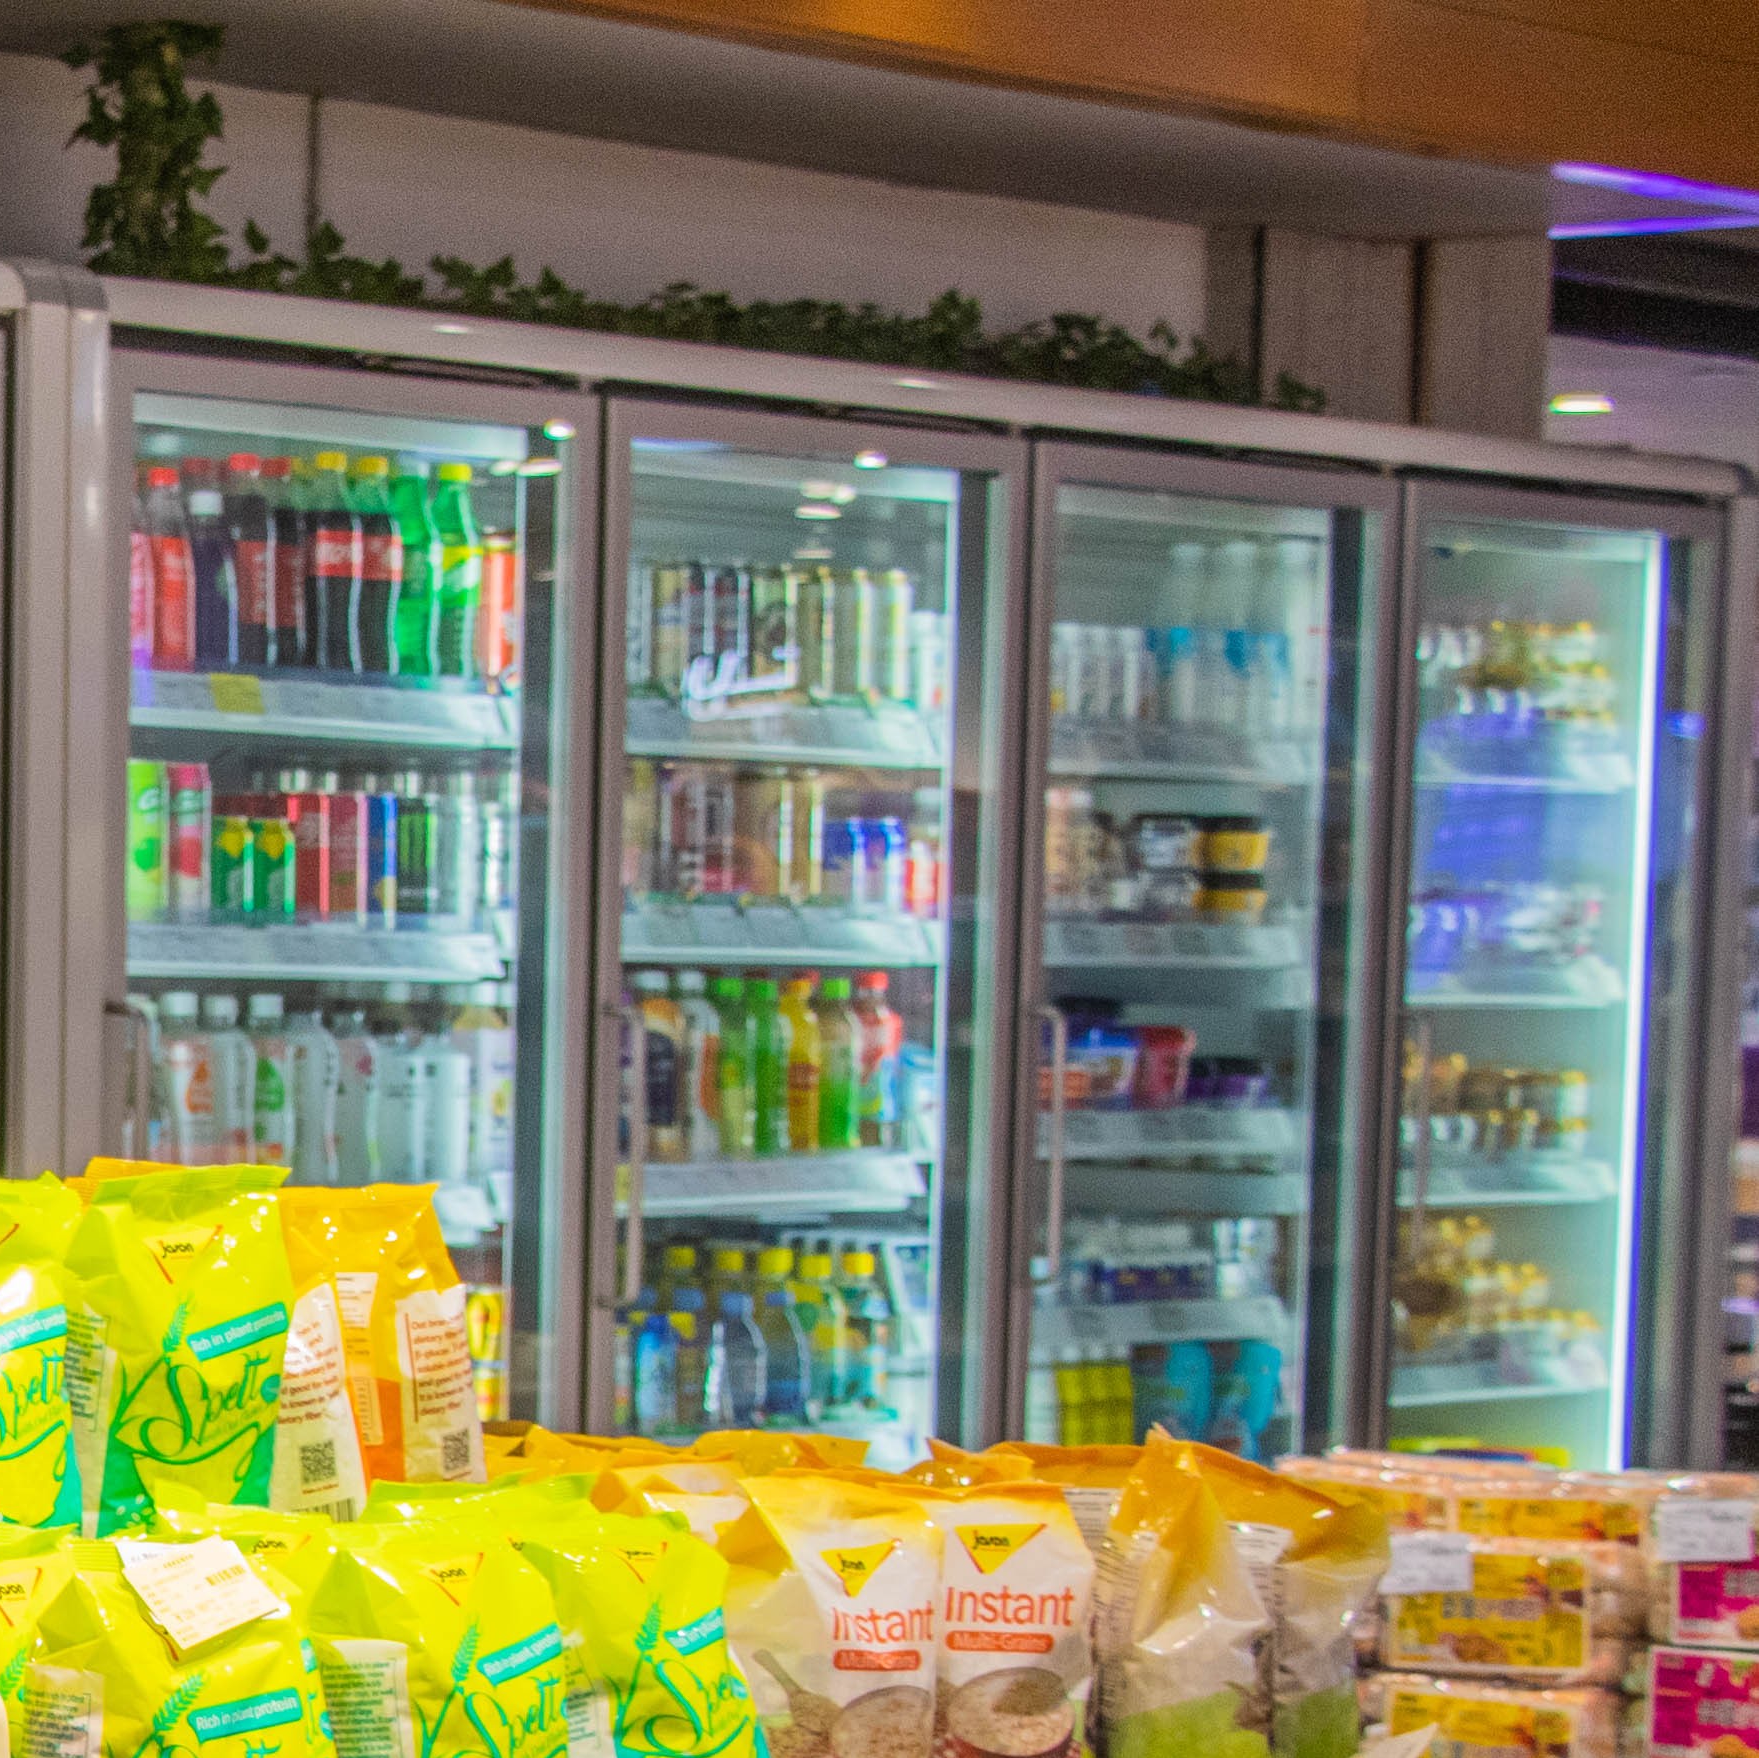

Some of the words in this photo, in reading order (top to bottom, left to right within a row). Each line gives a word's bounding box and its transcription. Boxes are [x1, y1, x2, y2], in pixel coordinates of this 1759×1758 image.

[831, 1605, 934, 1643] Instant
[944, 1584, 1074, 1627] Instant
[953, 1631, 1050, 1653] Multi-Grains
